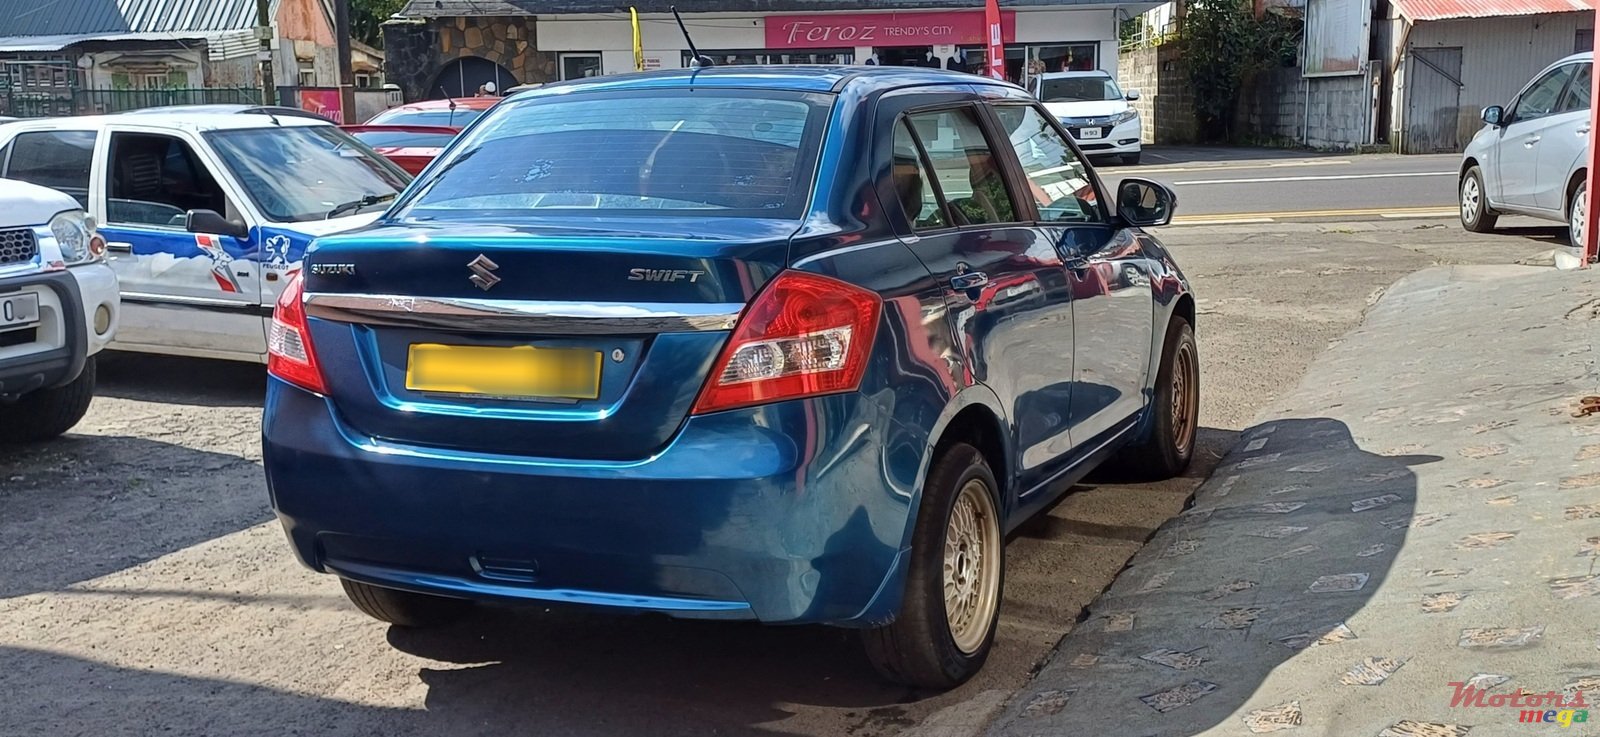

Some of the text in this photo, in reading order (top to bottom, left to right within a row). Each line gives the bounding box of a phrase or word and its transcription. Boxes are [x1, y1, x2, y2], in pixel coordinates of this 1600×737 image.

[782, 21, 953, 44] Feroz TRENDY'S CITY
[262, 263, 289, 271] PEUGEOT
[311, 263, 356, 275] SUZUKI
[627, 268, 705, 283] SWIFT
